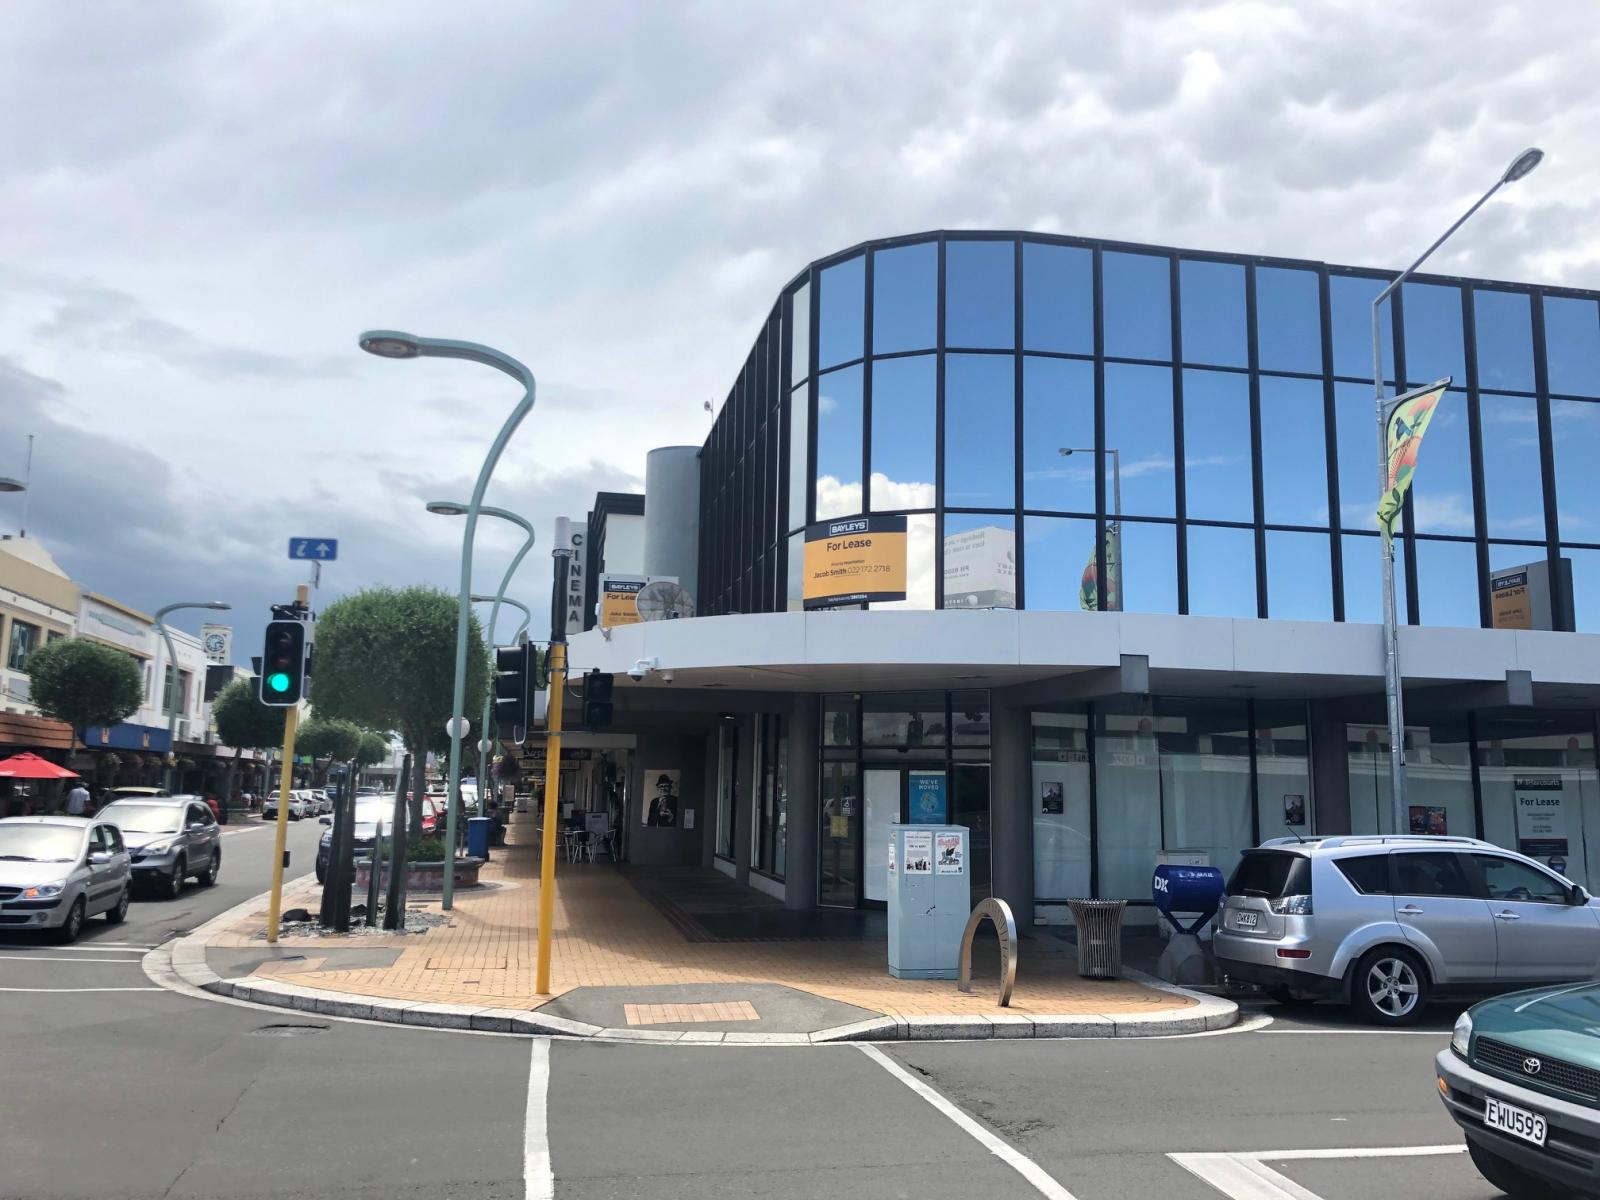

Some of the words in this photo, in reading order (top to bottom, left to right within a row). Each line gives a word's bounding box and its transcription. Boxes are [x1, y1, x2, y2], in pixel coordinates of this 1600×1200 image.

[831, 522, 865, 533] BAYLEYS
[826, 542, 841, 552] For
[842, 539, 872, 549] Lease
[568, 533, 583, 622] CINEMA
[813, 569, 830, 579] Jacob
[830, 567, 847, 577] Smith
[1520, 798, 1534, 806] For
[1536, 798, 1560, 806] Lease
[1154, 876, 1168, 893] DX
[1488, 1102, 1544, 1141] EWU593
